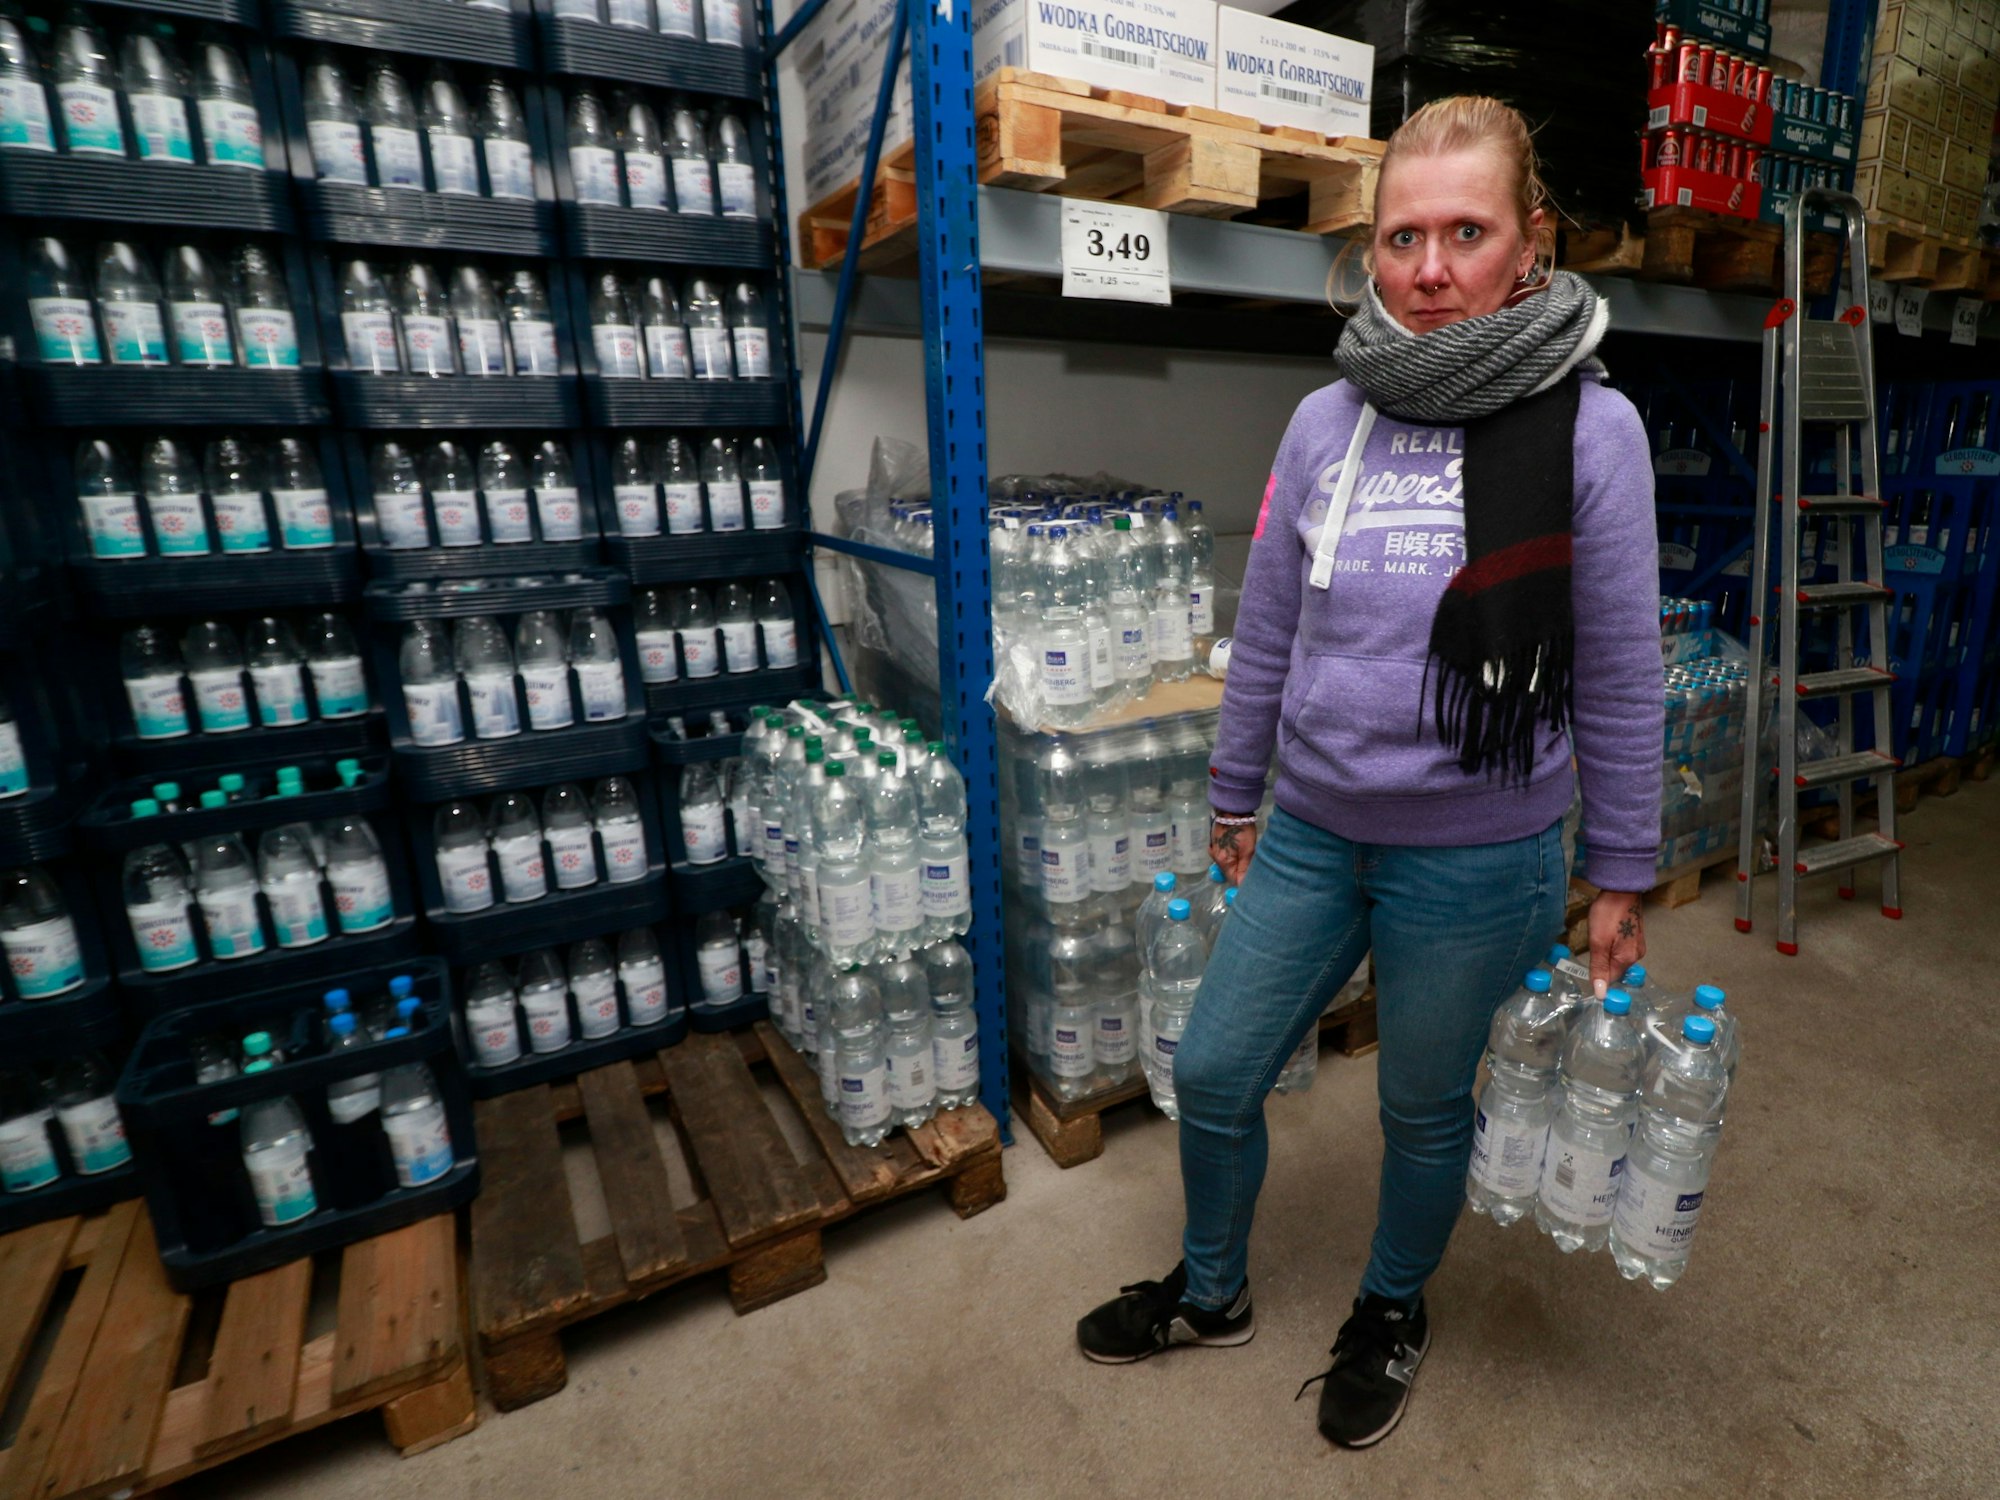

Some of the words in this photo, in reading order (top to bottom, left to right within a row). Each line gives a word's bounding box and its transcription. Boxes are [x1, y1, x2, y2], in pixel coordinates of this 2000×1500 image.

[1038, 2, 1099, 34] WODKA
[1104, 13, 1209, 61] GORBATSCHOW
[1225, 50, 1274, 77] WODKA
[1280, 58, 1365, 100] GORBATSCHOW
[1088, 229, 1150, 262] 3,49
[1390, 432, 1463, 455] REAL
[1336, 560, 1374, 573] RADE.
[1384, 561, 1433, 576] MARK.
